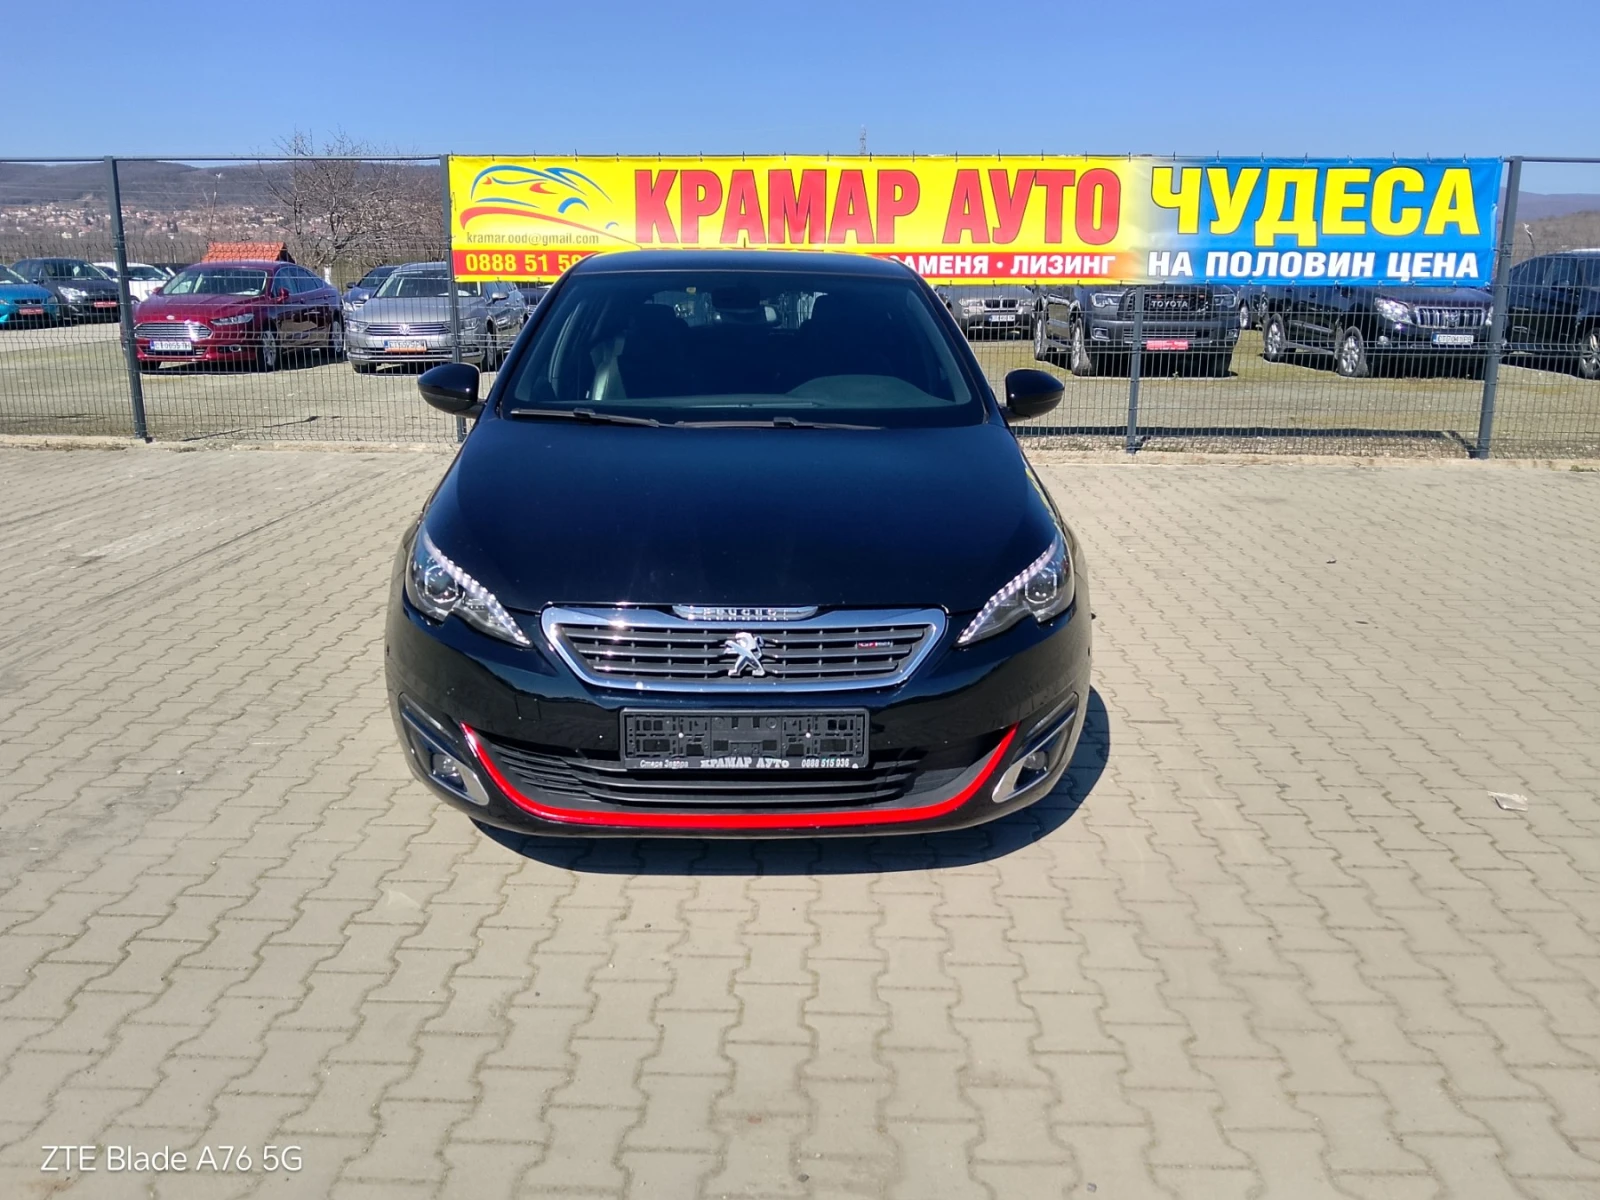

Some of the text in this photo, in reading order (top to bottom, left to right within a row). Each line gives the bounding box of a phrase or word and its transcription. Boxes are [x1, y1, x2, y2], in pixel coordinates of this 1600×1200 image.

[634, 168, 1121, 246] КРАМАР АУТО
[1150, 166, 1481, 247] ЧУДЕСА
[466, 232, 599, 246] kramar.ood@gmail.com
[465, 254, 517, 272] 0888
[524, 254, 549, 272] 51
[889, 255, 1116, 275] АМЕНЯ ЛИЗИНГ
[1148, 251, 1479, 279] НА ПОЛОВИН ЦЕНА
[1152, 300, 1188, 308] TOYOTA
